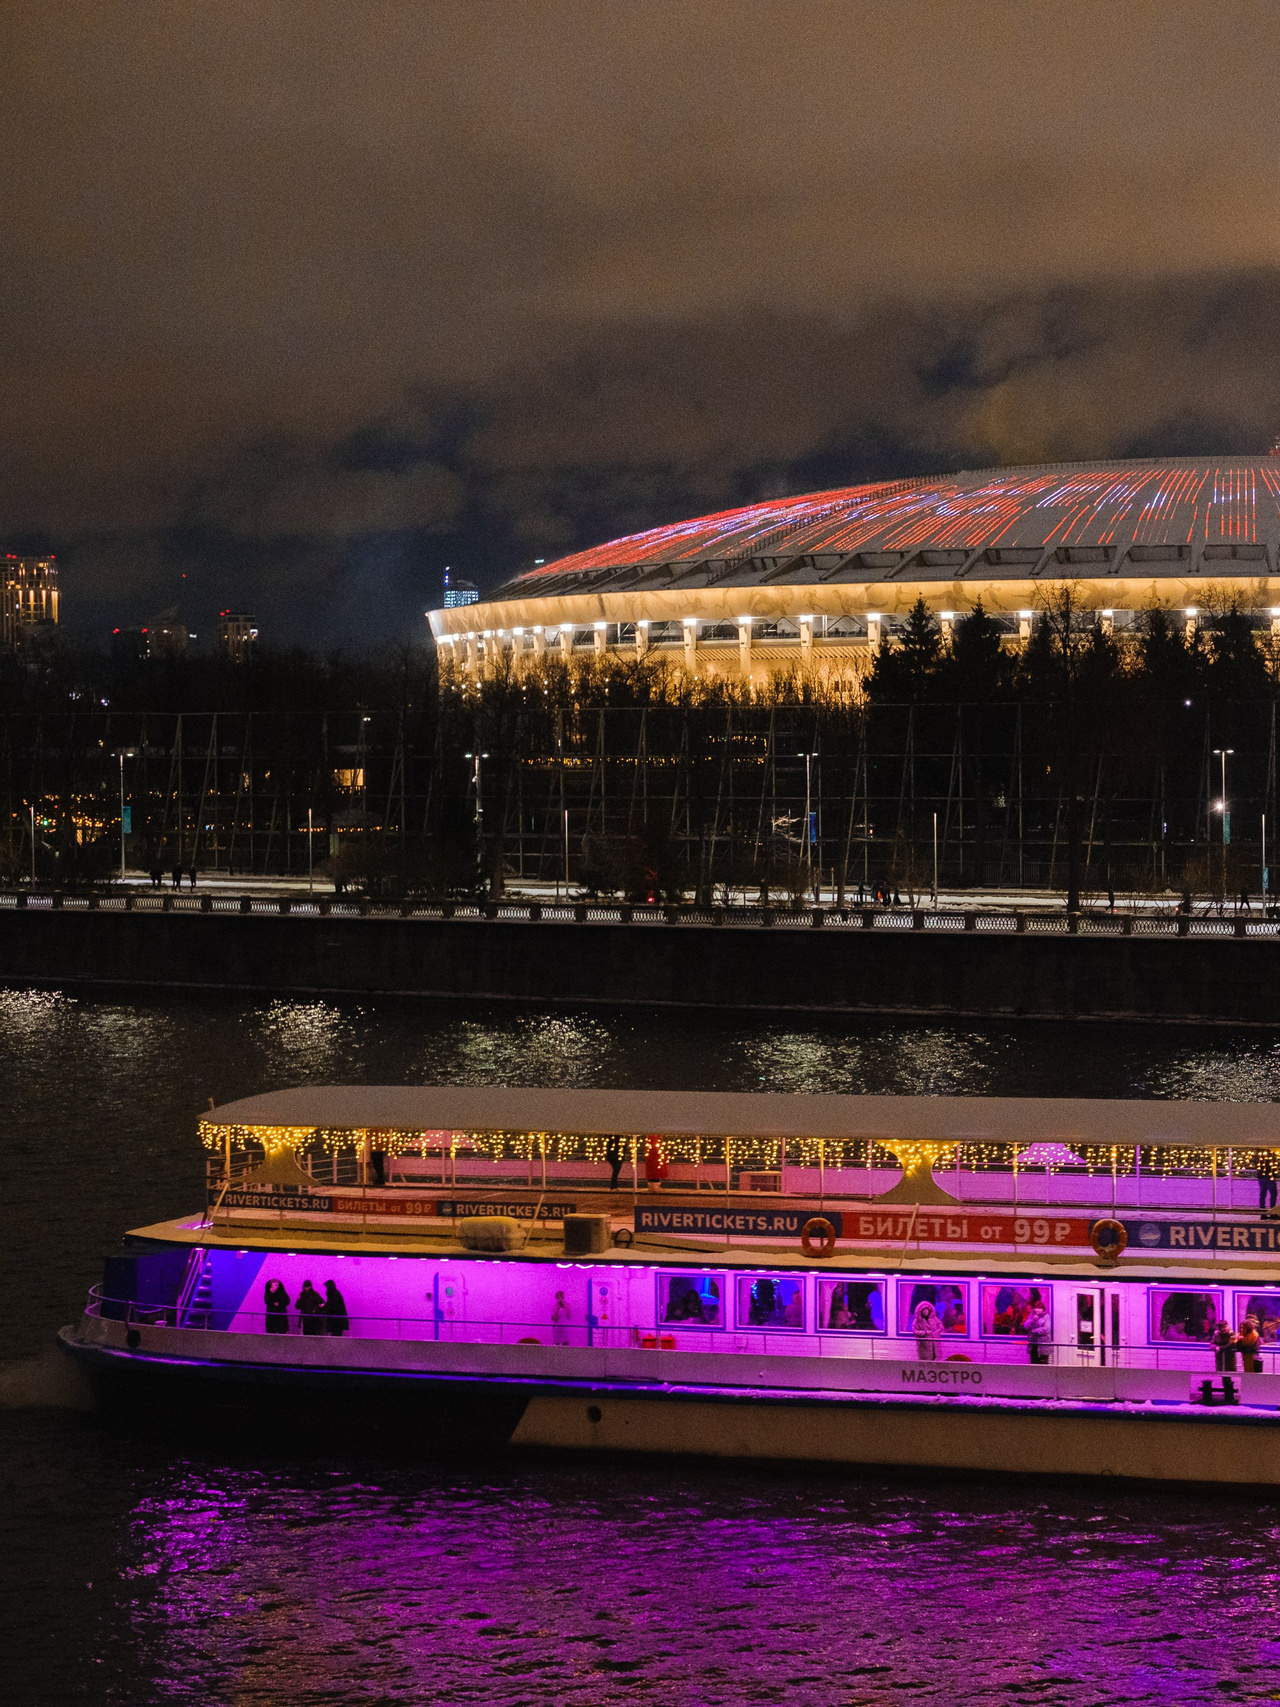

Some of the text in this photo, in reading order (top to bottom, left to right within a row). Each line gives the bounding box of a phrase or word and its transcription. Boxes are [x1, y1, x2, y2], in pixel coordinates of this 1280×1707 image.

[225, 1194, 329, 1210] RIVERTICKETS.RU
[337, 1200, 387, 1212] БИЛЕТЫ
[456, 1204, 571, 1218] RIVERTICKETS.RU
[641, 1211, 799, 1232] RIVERTICKETS.RU
[859, 1216, 968, 1239] БИЛЕТЫ
[980, 1225, 1003, 1240] от
[901, 1369, 982, 1384] МАЭСТРО
